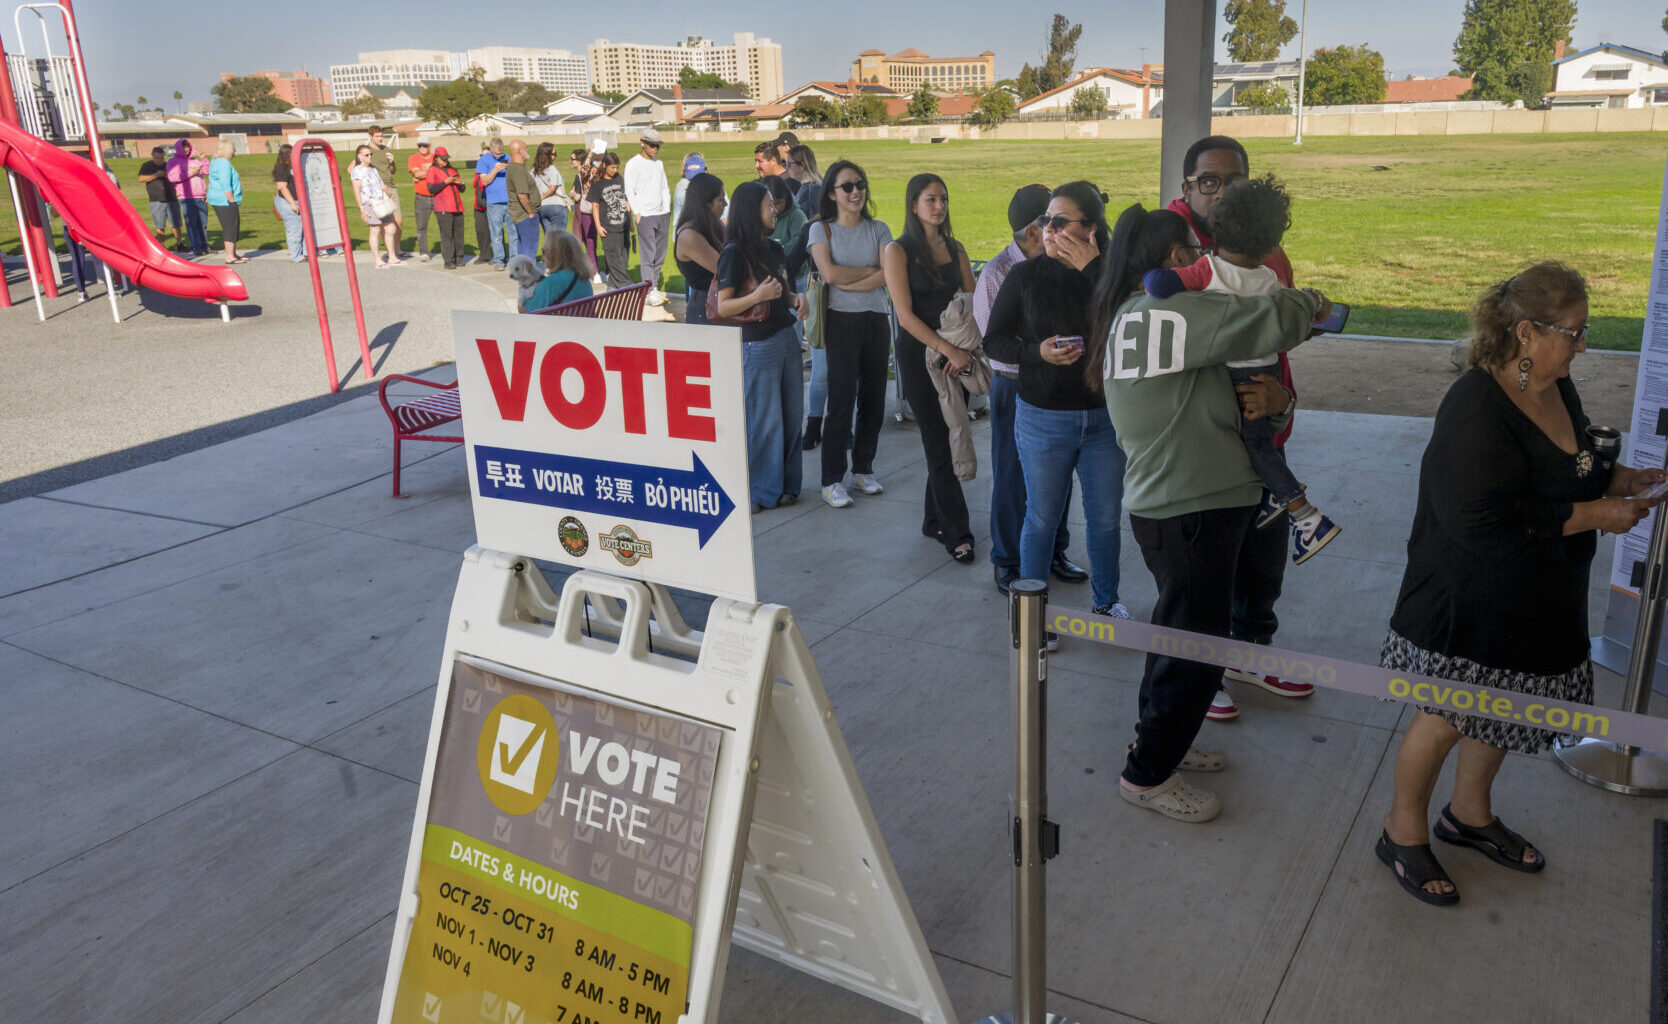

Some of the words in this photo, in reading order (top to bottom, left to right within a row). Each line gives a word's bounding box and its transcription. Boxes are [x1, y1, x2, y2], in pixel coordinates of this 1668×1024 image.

[475, 338, 717, 443] VOTE
[485, 459, 526, 489] 투표
[532, 468, 585, 496] VOTAR
[595, 474, 635, 504] 投票
[644, 477, 668, 509] BỎ
[670, 482, 720, 516] PHIẾU
[601, 536, 620, 550] VOTE
[619, 540, 651, 554] CENTERS
[1046, 613, 1115, 642] .com
[1388, 677, 1610, 737] ocvote.com
[569, 730, 681, 806] VOTE
[559, 782, 650, 845] HERE
[450, 840, 500, 876] DATES
[502, 863, 514, 883] &
[519, 869, 580, 910] HOURS
[436, 912, 466, 939] NOV
[469, 929, 476, 945] 1
[487, 938, 523, 966] NOV
[525, 955, 535, 973] 3
[561, 972, 572, 990] 8
[575, 979, 604, 1004] AM
[618, 996, 629, 1014] 8
[635, 1002, 662, 1024] PM
[439, 881, 471, 906] OCT
[471, 895, 491, 916] 25
[502, 908, 536, 934] OCT
[536, 922, 554, 943] 31
[574, 939, 585, 957] 8
[587, 946, 617, 973] AM
[627, 963, 638, 982] 5
[643, 969, 671, 996] PM
[432, 943, 462, 970] NOV
[462, 961, 471, 978] 4
[556, 1005, 568, 1022] 7
